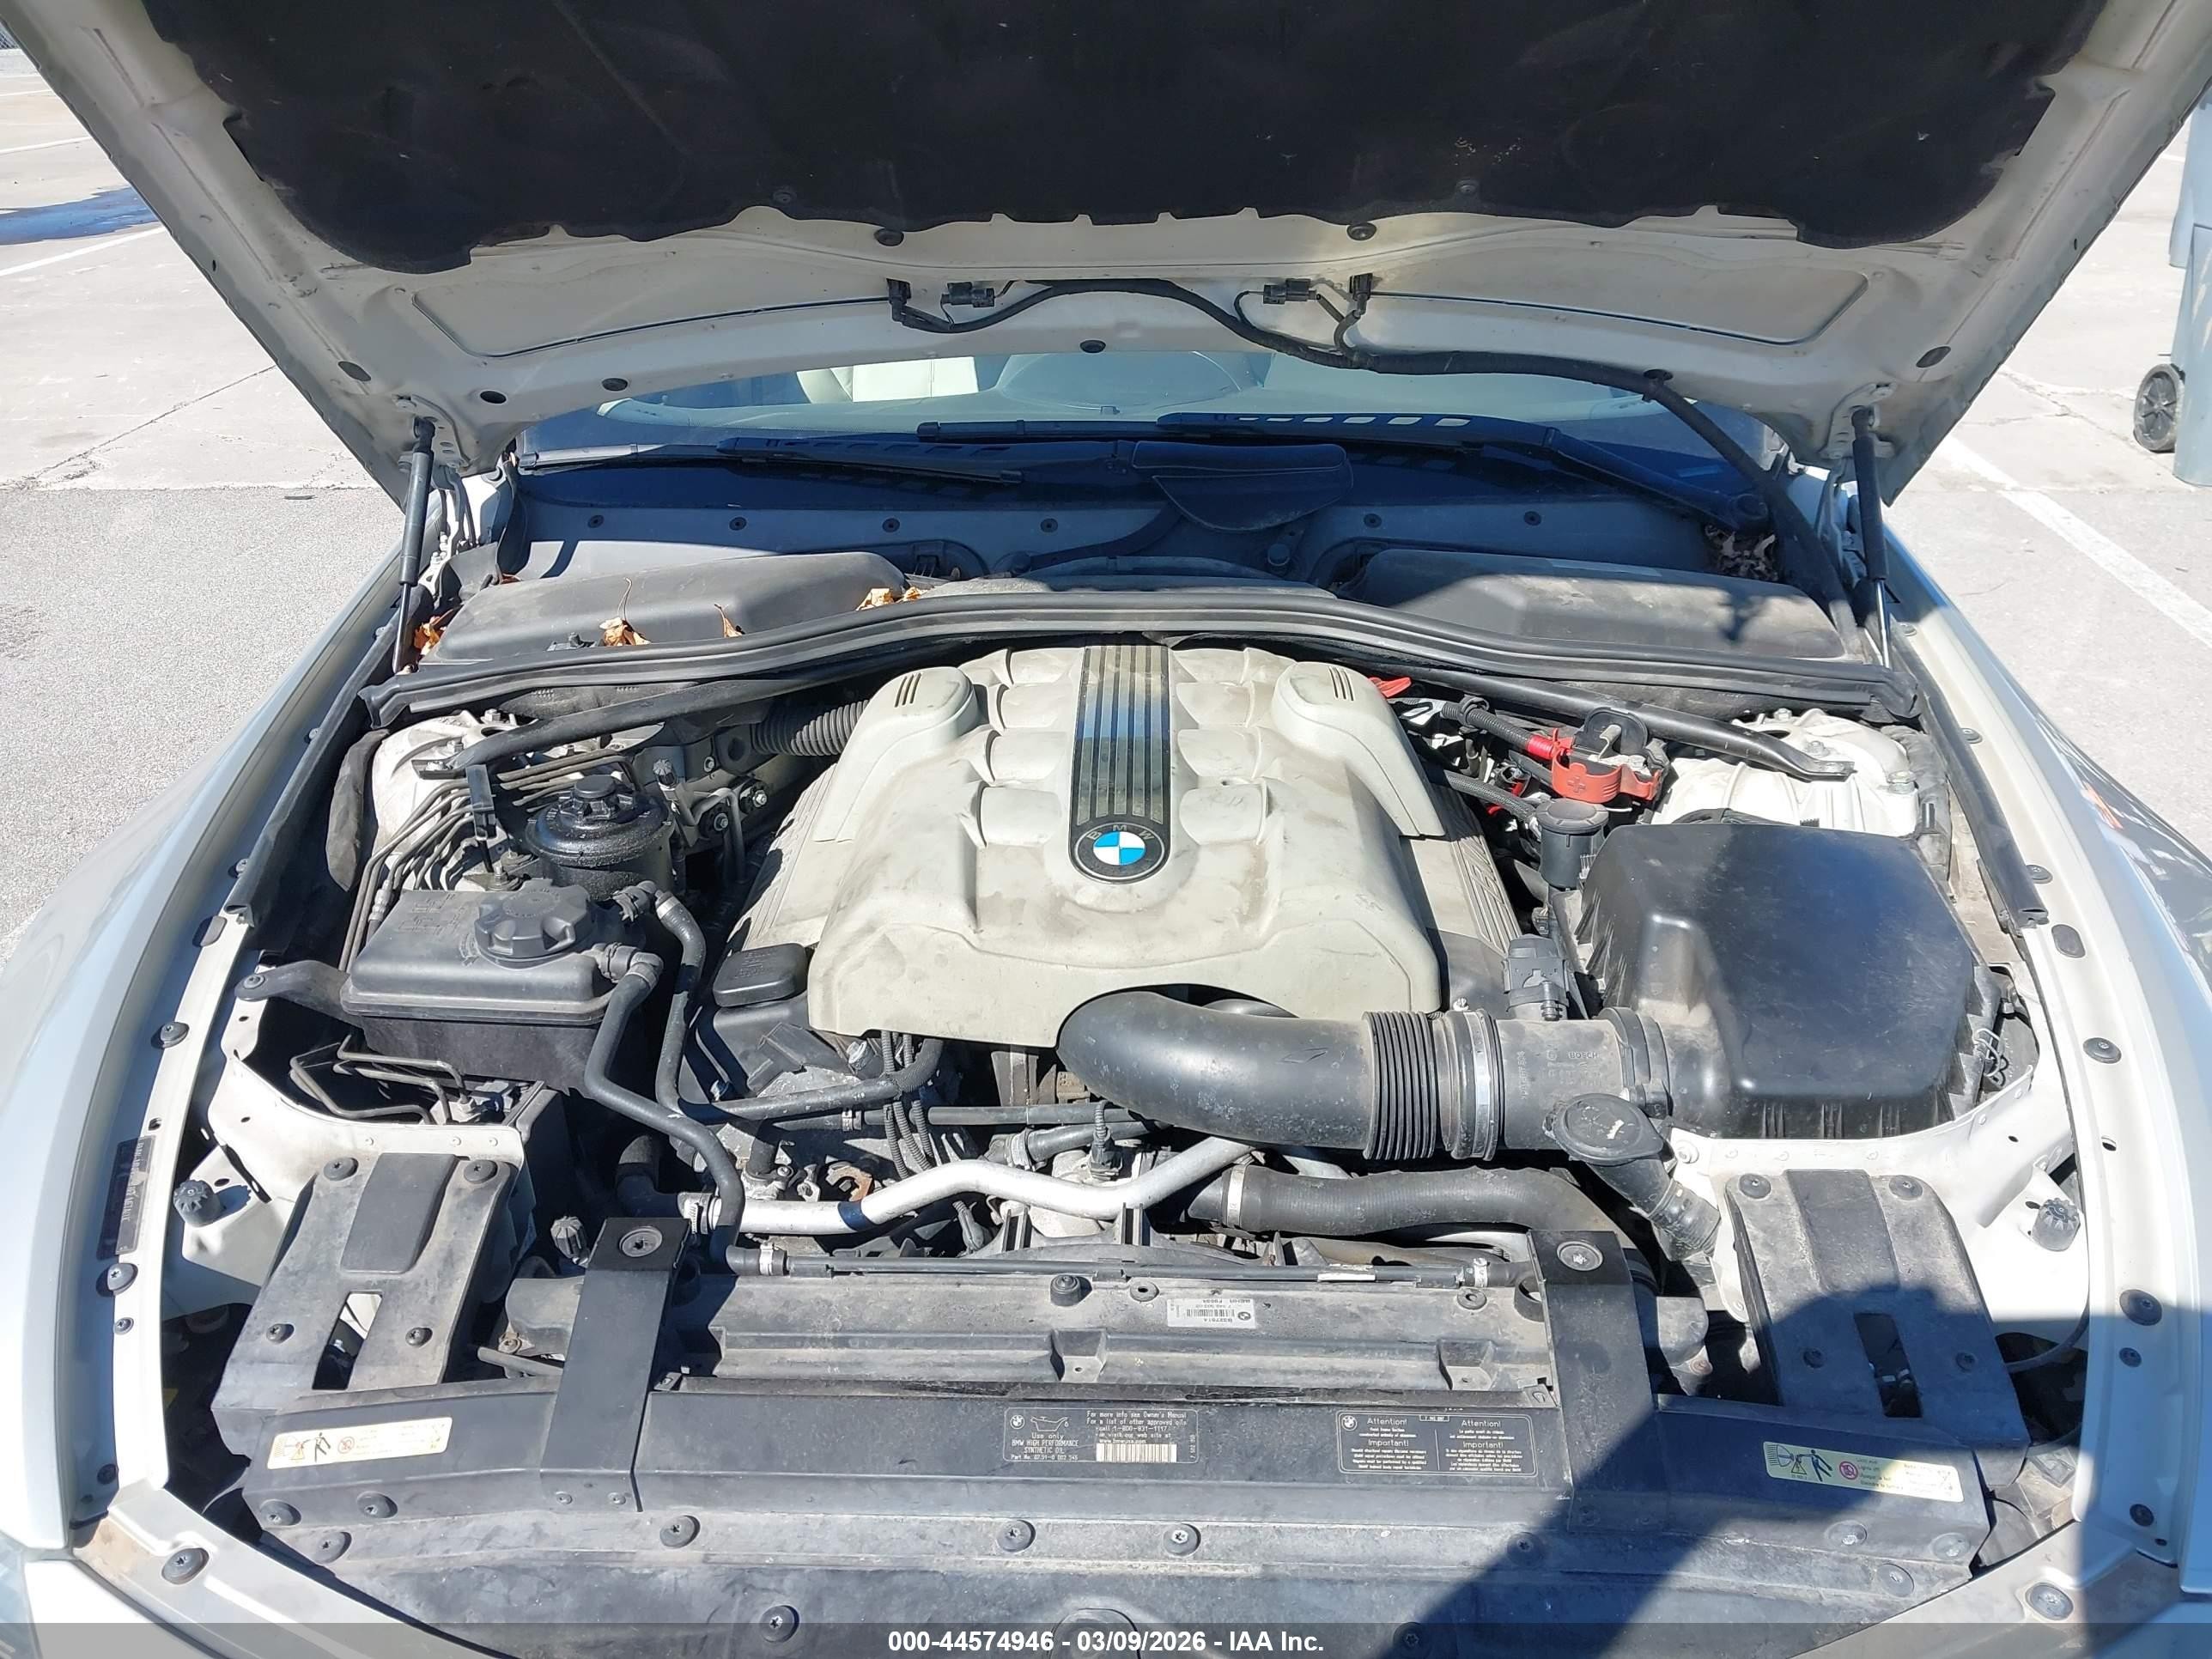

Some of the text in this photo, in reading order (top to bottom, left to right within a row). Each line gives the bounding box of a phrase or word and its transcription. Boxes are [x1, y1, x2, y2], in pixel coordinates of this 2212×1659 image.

[1086, 824, 1155, 841] BMW
[1568, 1051, 1599, 1060] BOSCH
[1367, 1417, 1407, 1425] Attention!
[1461, 1419, 1501, 1428] Attention!
[1368, 1438, 1409, 1447] Important!
